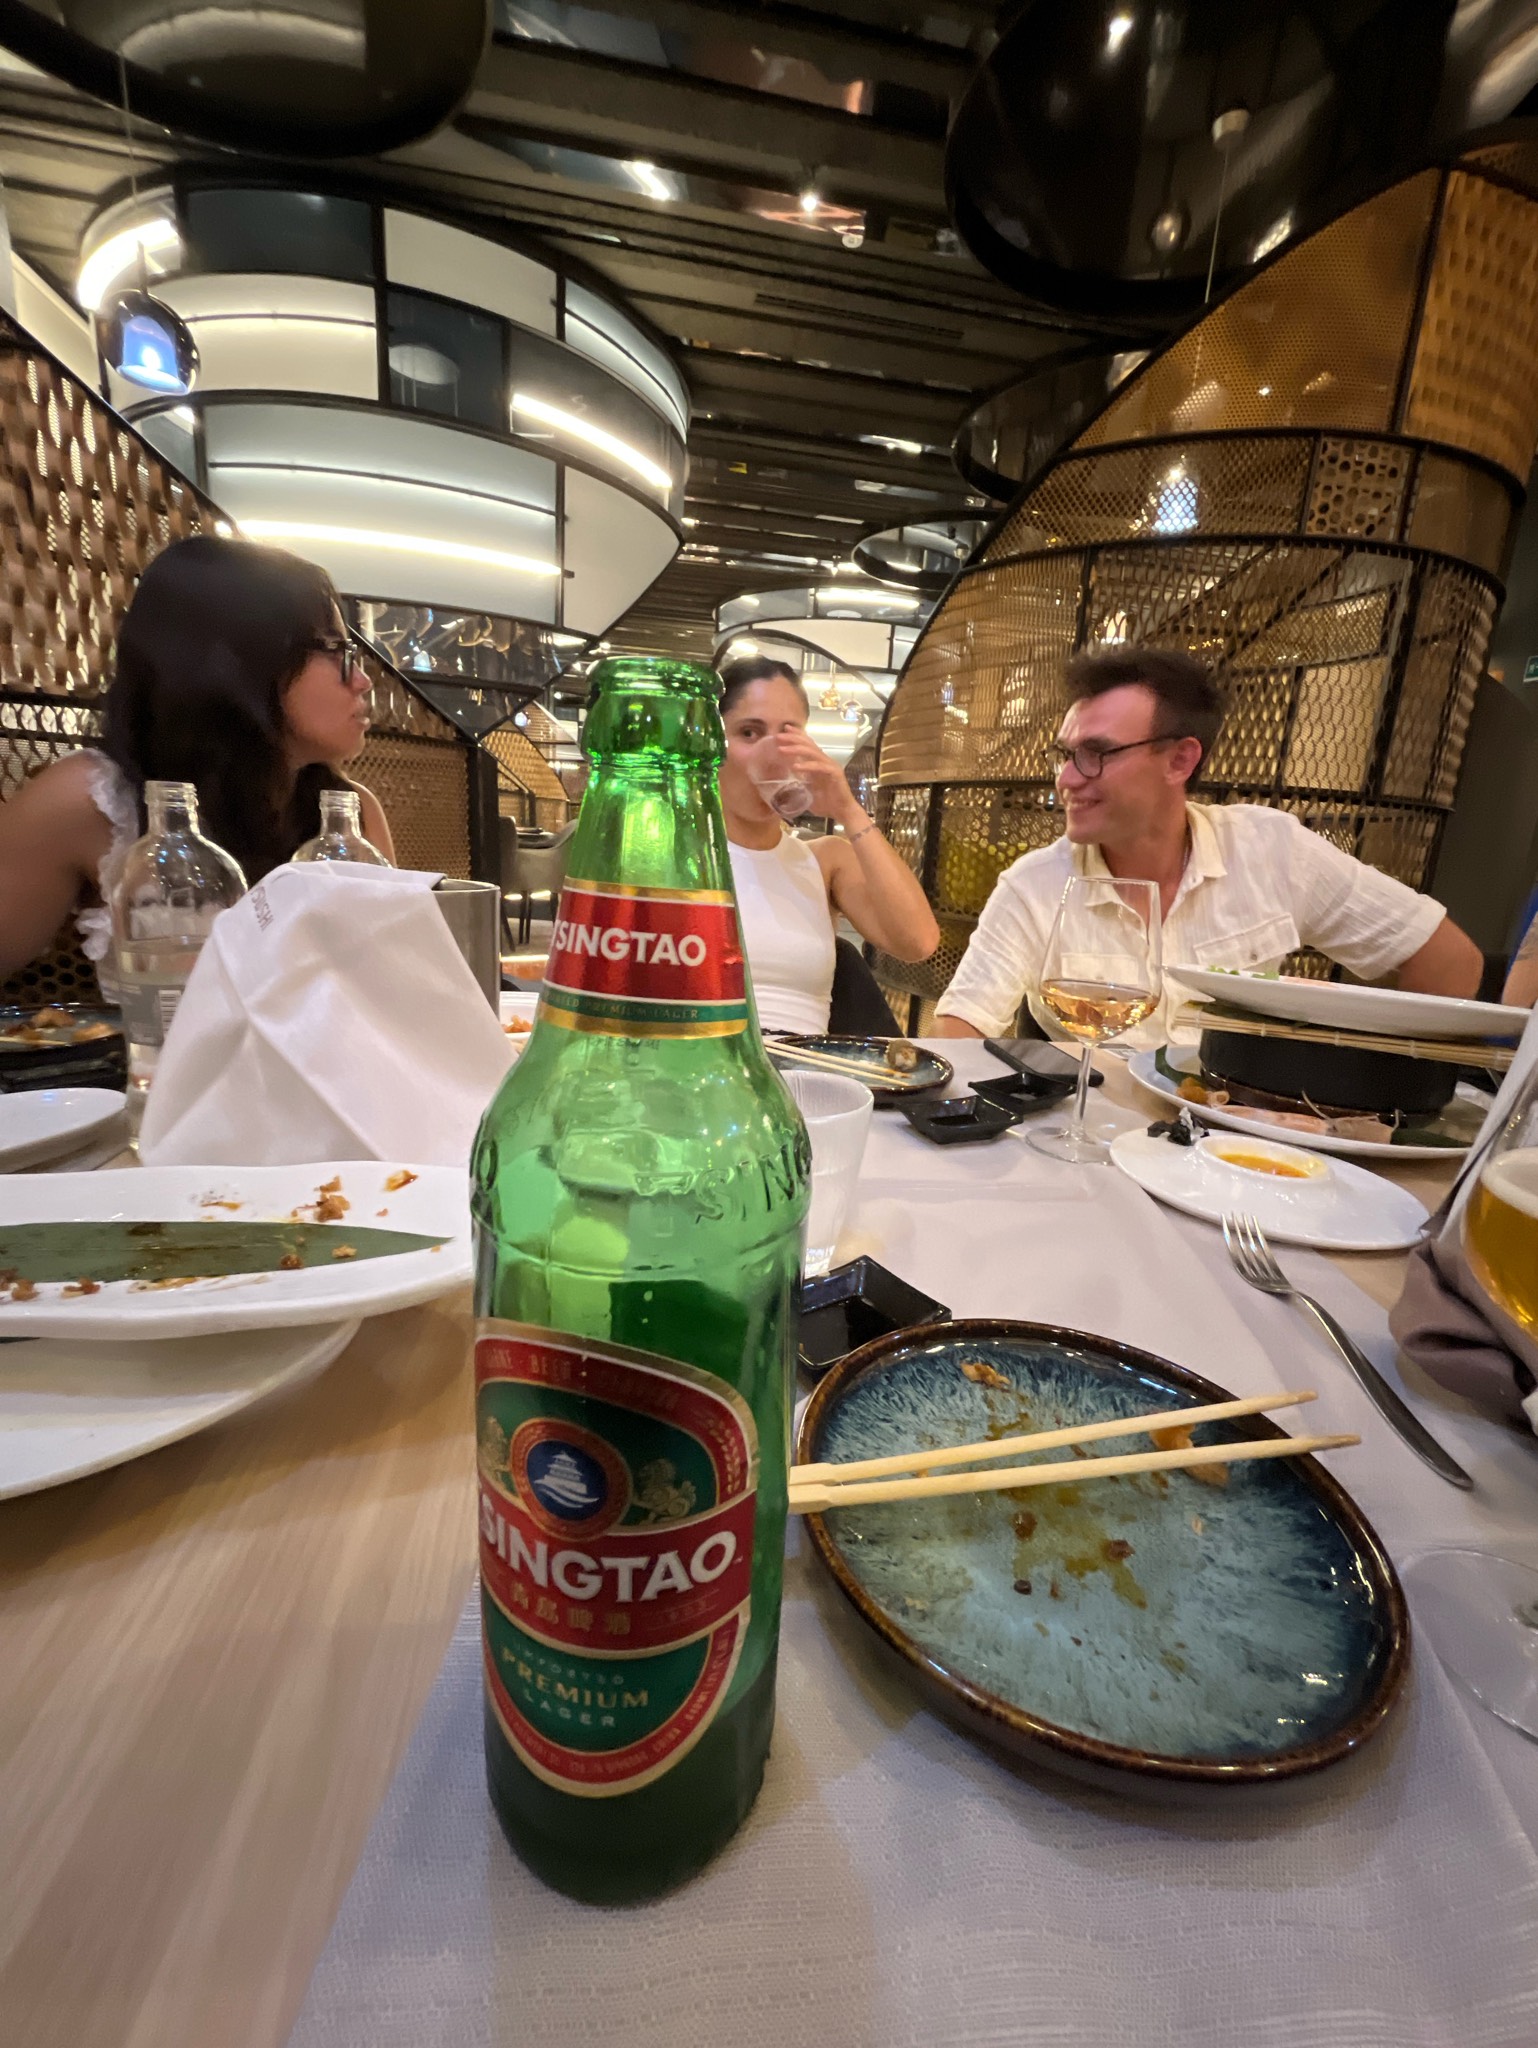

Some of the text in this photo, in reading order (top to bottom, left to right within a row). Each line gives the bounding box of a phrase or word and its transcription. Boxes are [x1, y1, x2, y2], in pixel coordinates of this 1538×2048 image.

[479, 1490, 737, 1604] SINGTAO
[502, 1647, 649, 1710] PREMIUM
[523, 1688, 616, 1728] LAGER
